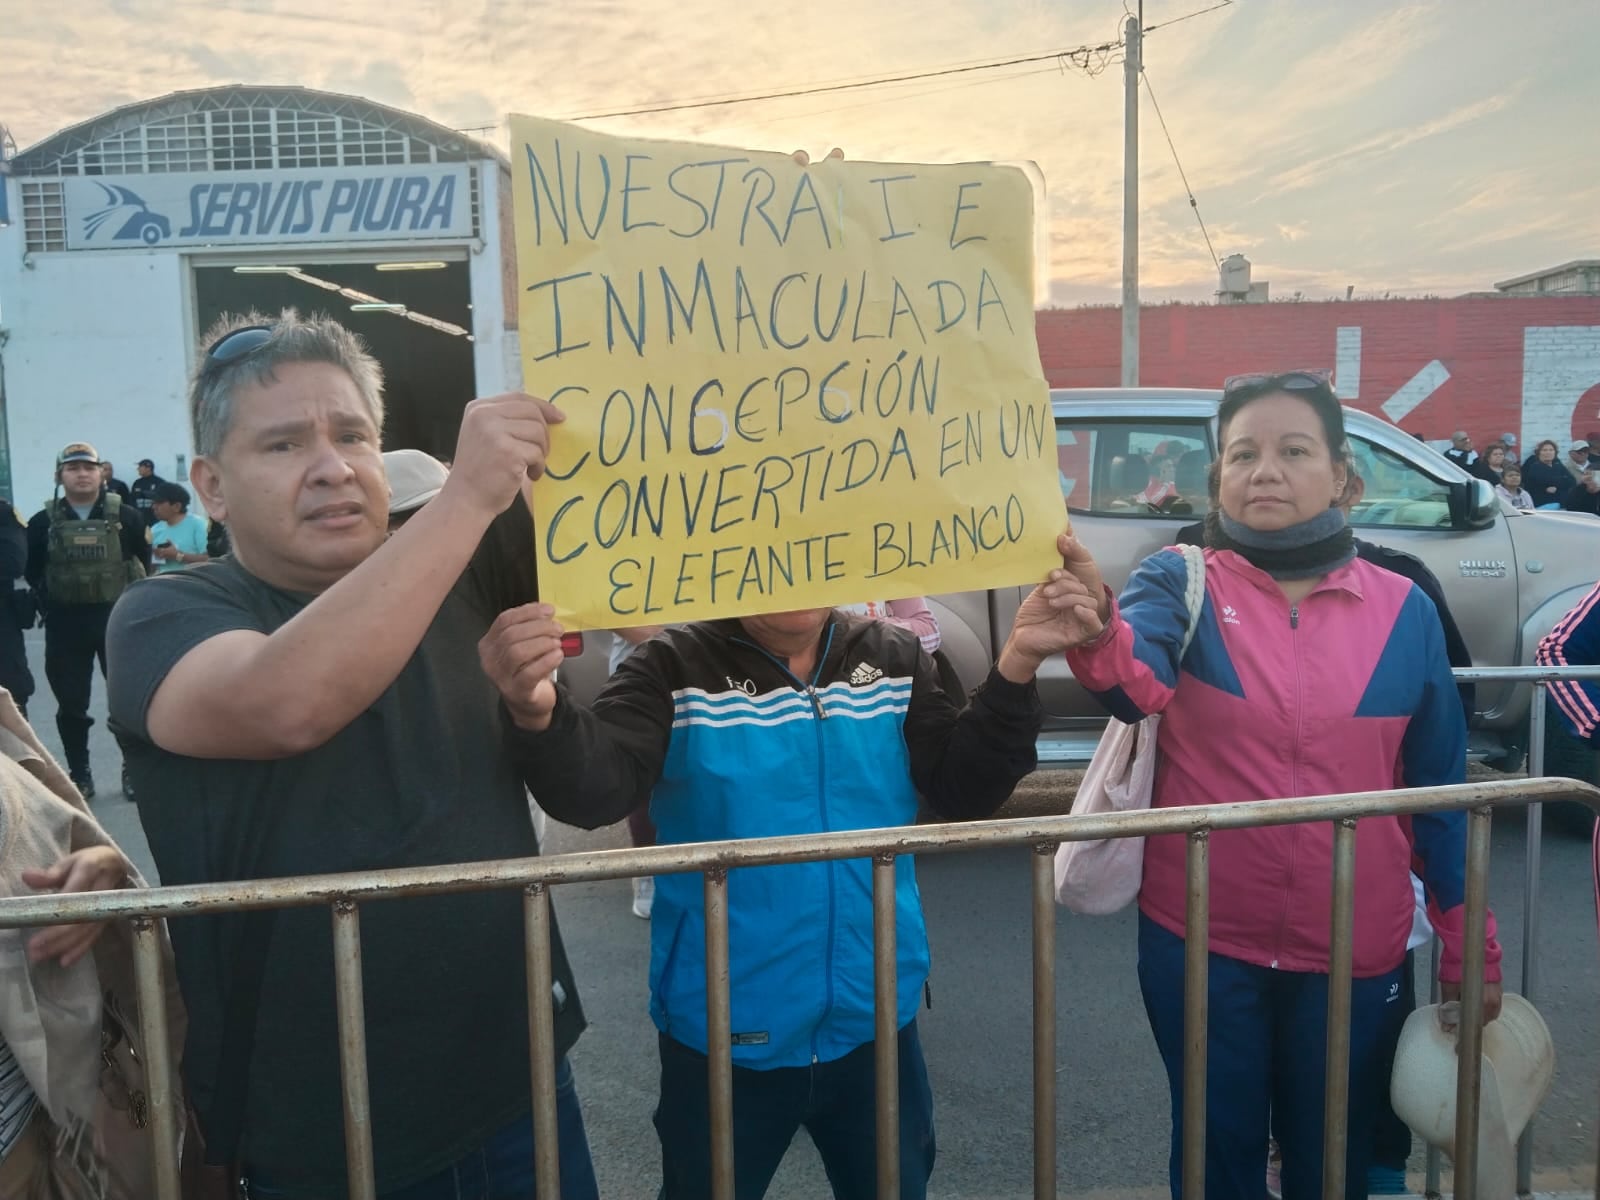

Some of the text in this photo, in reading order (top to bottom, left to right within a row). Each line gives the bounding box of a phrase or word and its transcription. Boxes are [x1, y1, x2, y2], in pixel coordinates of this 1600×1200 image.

[179, 174, 456, 238] SERVIS PIURA
[526, 139, 832, 249] NUESTRA
[527, 257, 1014, 361] INMACULADA
[545, 400, 1047, 565] CONVERTIDA EN UN
[608, 493, 1025, 615] ELEFANTE BLANCO
[850, 668, 883, 684] adidas
